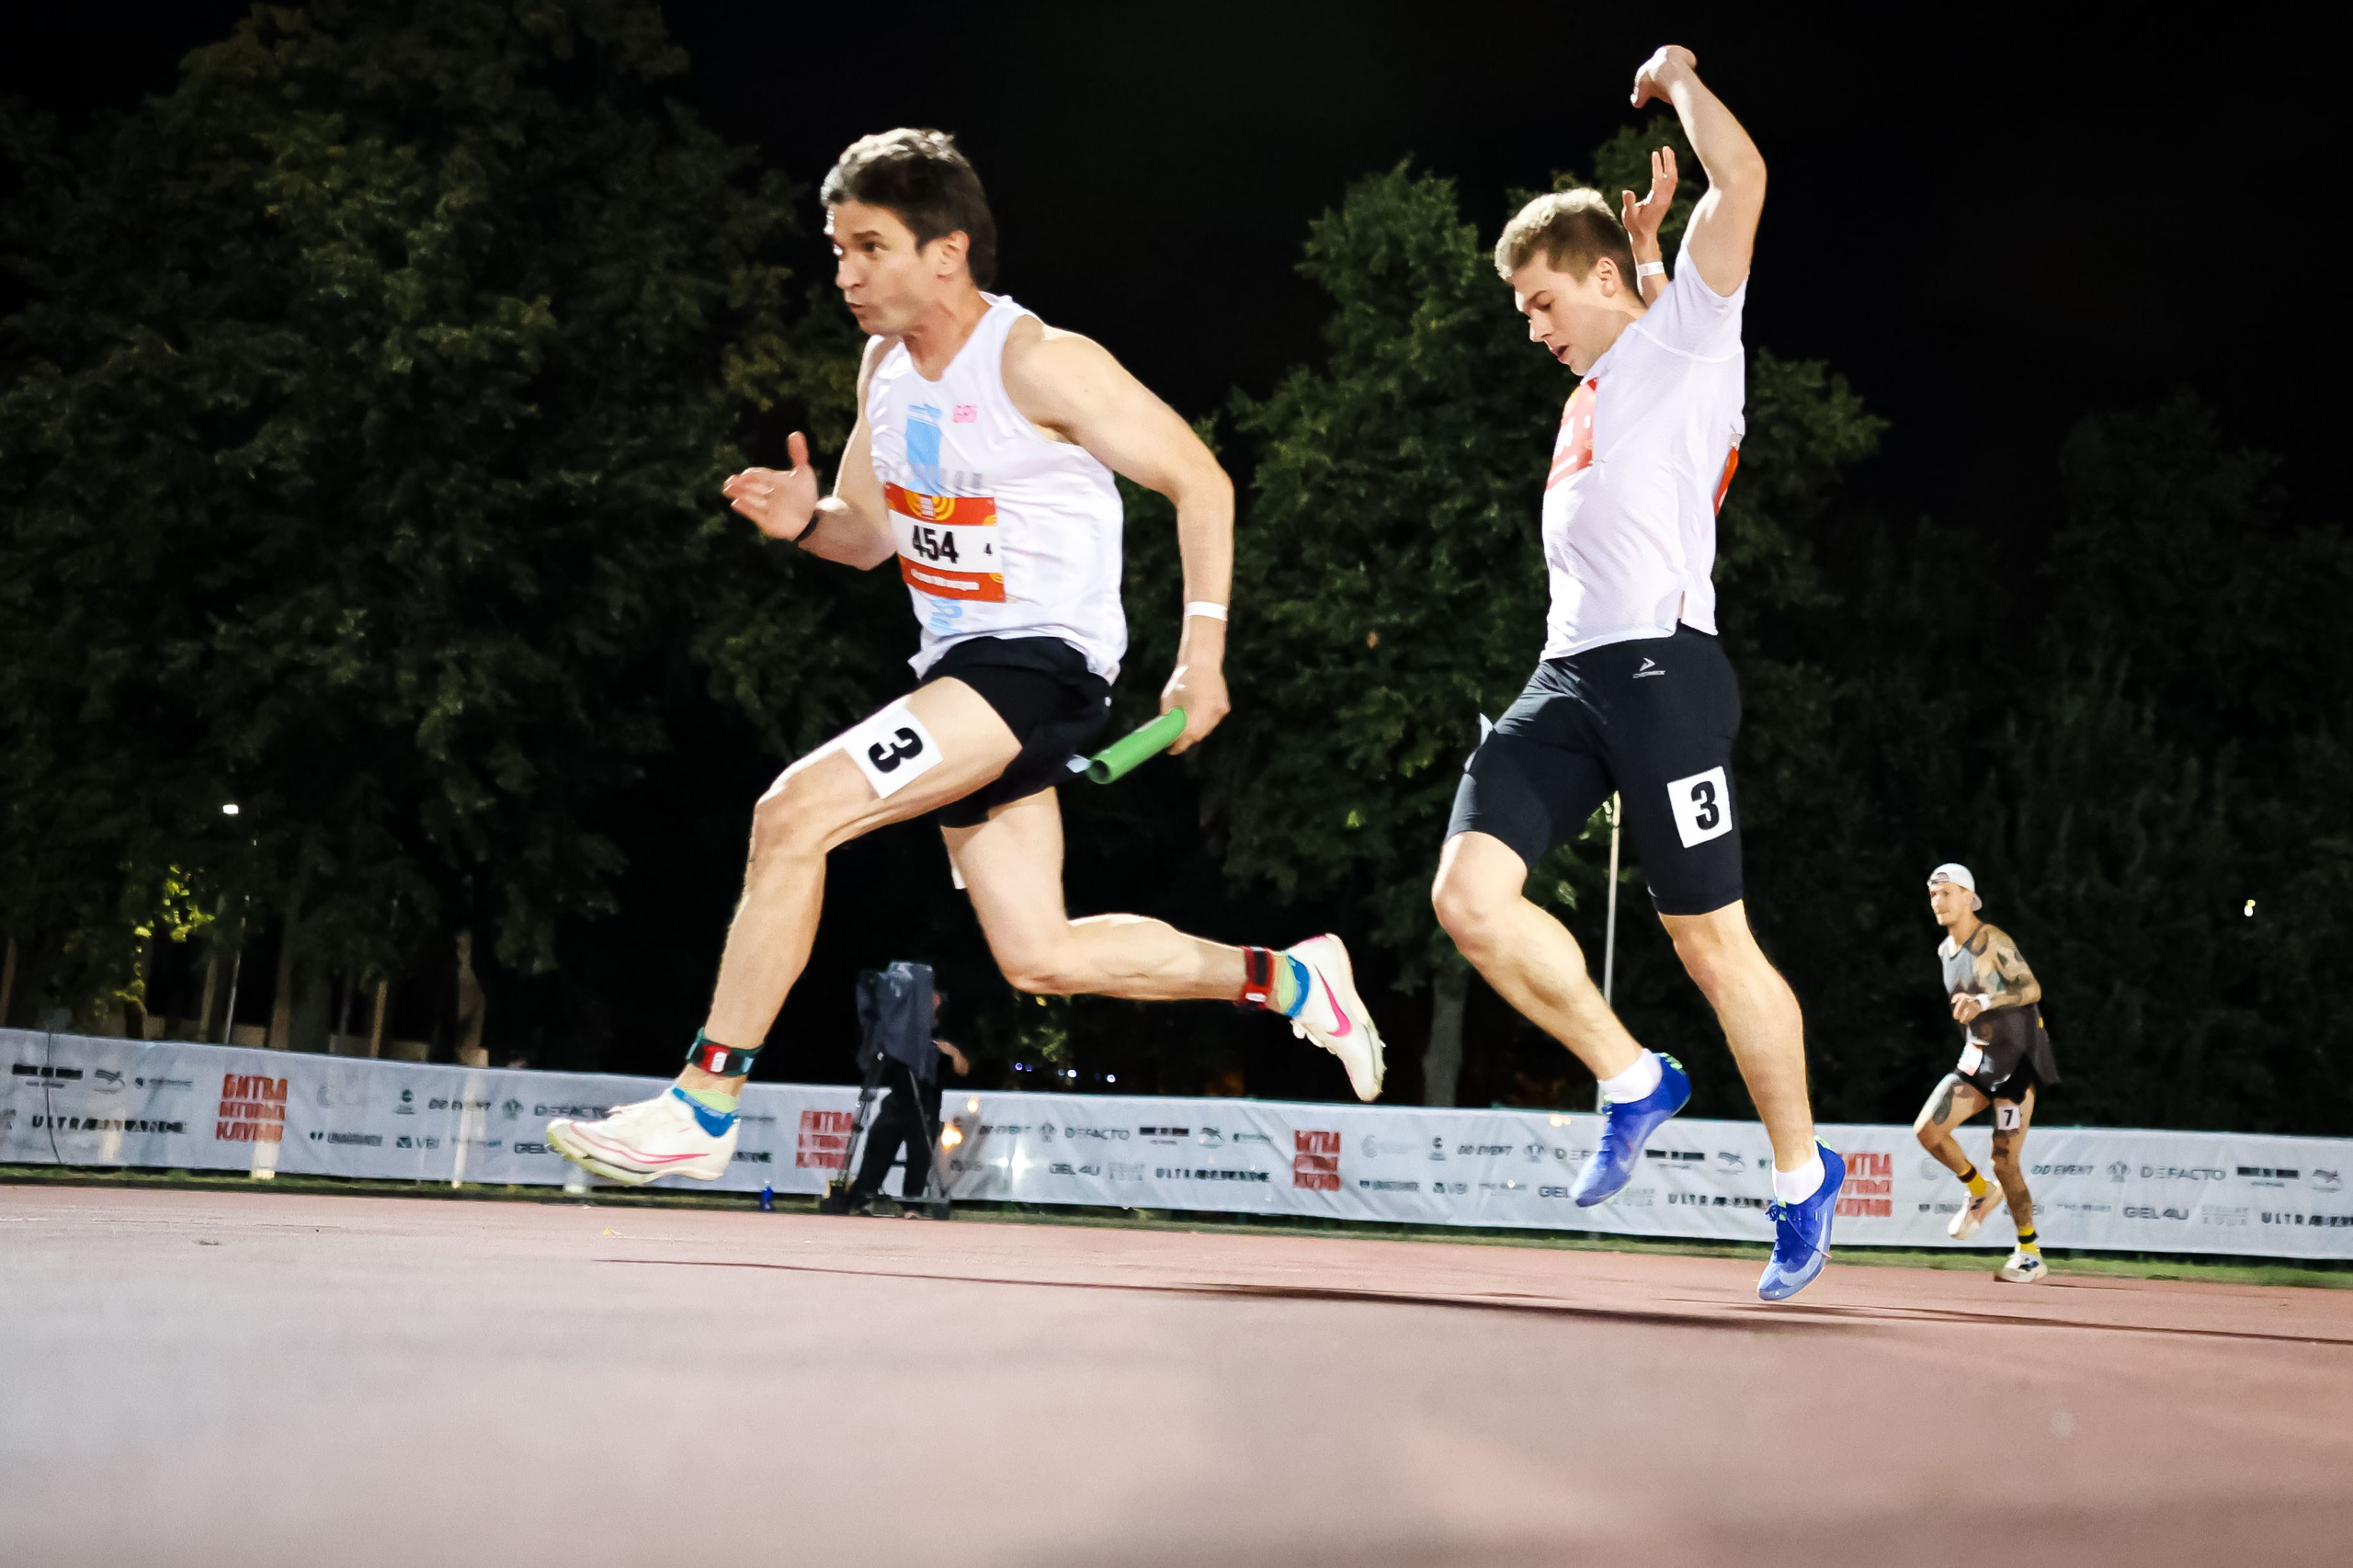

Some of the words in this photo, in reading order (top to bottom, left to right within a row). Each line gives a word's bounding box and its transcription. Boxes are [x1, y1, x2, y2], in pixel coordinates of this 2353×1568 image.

[912, 524, 961, 564] 454
[868, 727, 924, 774] 3
[1690, 780, 1721, 831] 3
[2003, 1108, 2014, 1127] 7
[2140, 1165, 2226, 1181] DEFACTO
